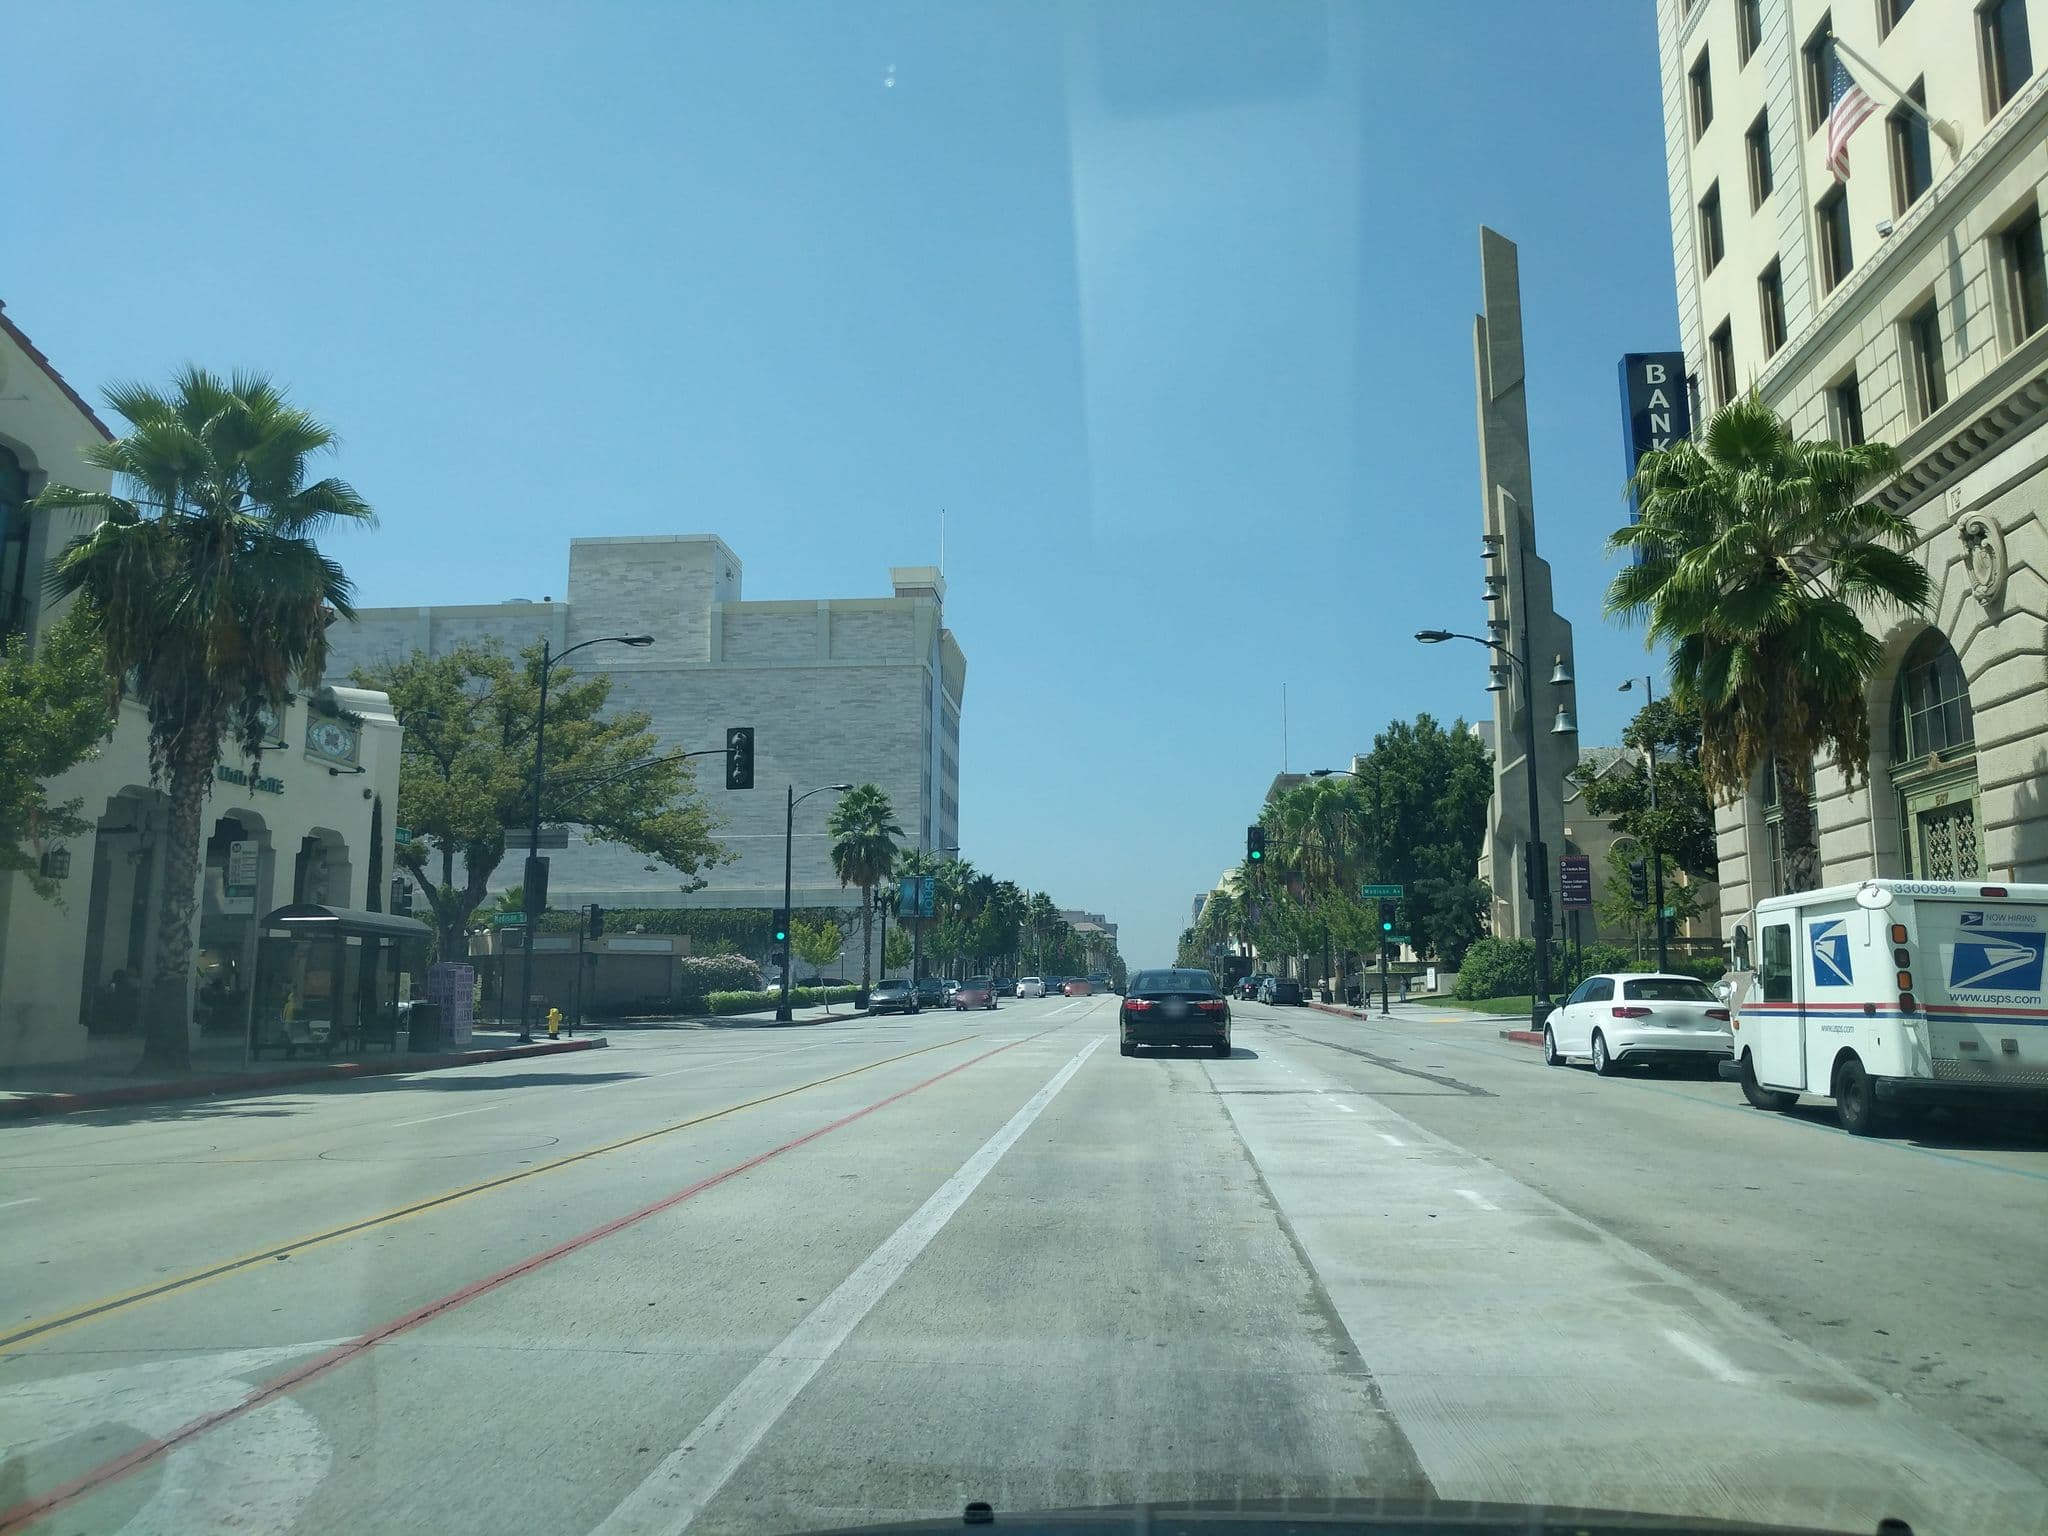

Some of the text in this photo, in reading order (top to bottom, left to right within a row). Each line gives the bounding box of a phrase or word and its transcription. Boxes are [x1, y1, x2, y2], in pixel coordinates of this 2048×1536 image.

[1645, 364, 1671, 453] BANK
[1985, 912, 2037, 923] NOW HIRING
[1949, 993, 2041, 1005] www.usps.com
